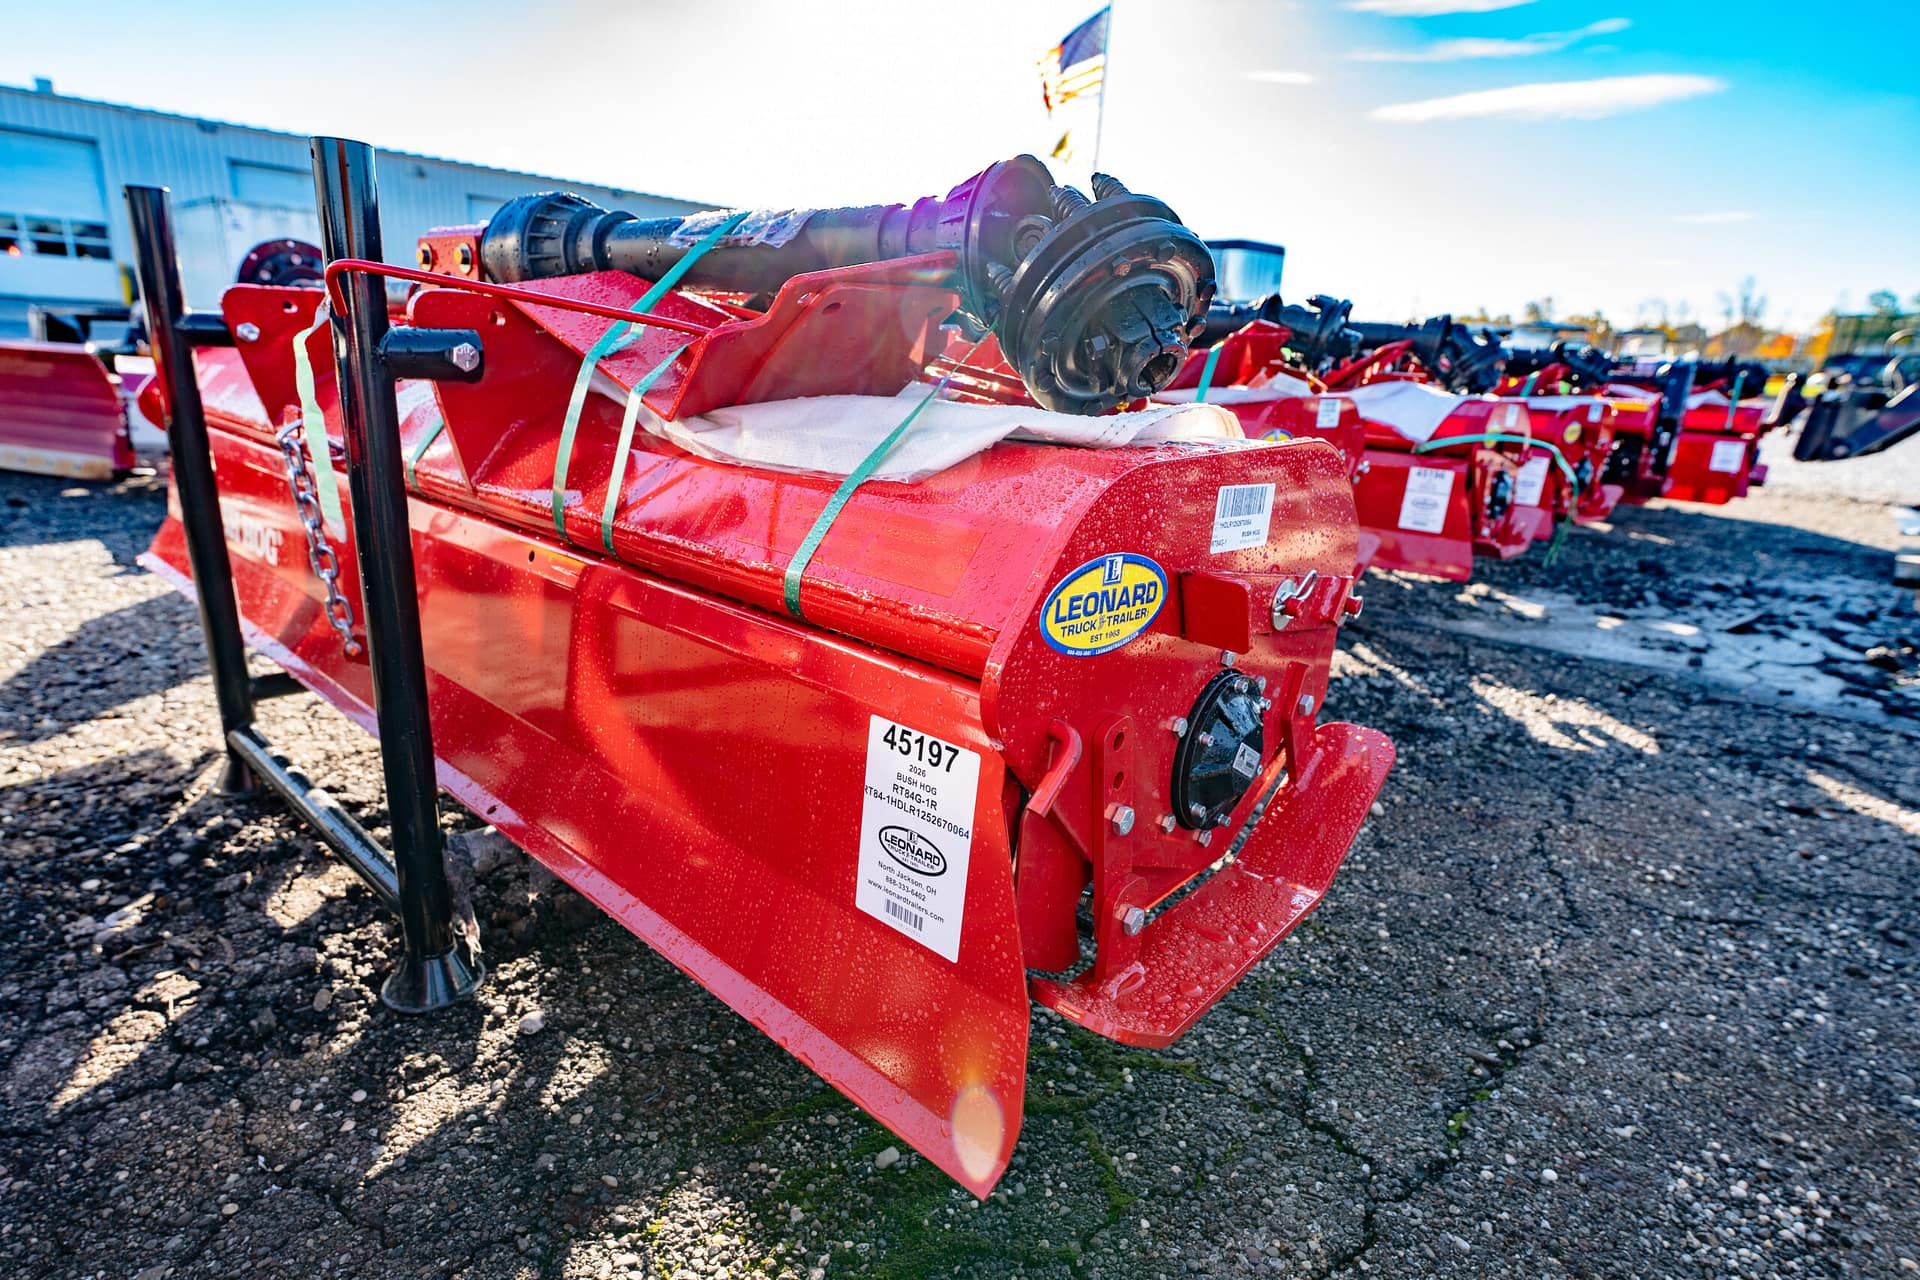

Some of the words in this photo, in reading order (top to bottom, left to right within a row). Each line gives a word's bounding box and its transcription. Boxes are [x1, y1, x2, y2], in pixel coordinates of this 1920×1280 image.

[1054, 581, 1158, 624] LEONARD
[1060, 619, 1097, 638] TRUCK
[1106, 608, 1148, 627] TRAILER
[1090, 633, 1103, 643] EST
[883, 724, 960, 773] 45197
[896, 772, 918, 787] BUSH
[920, 782, 937, 796] HOG
[909, 764, 926, 778] 2026
[892, 783, 938, 811] RT84G-1R
[884, 831, 941, 867] LEONARD
[878, 860, 895, 875] North
[925, 885, 937, 896] OH
[867, 879, 945, 924] www.leonardtrailers.com
